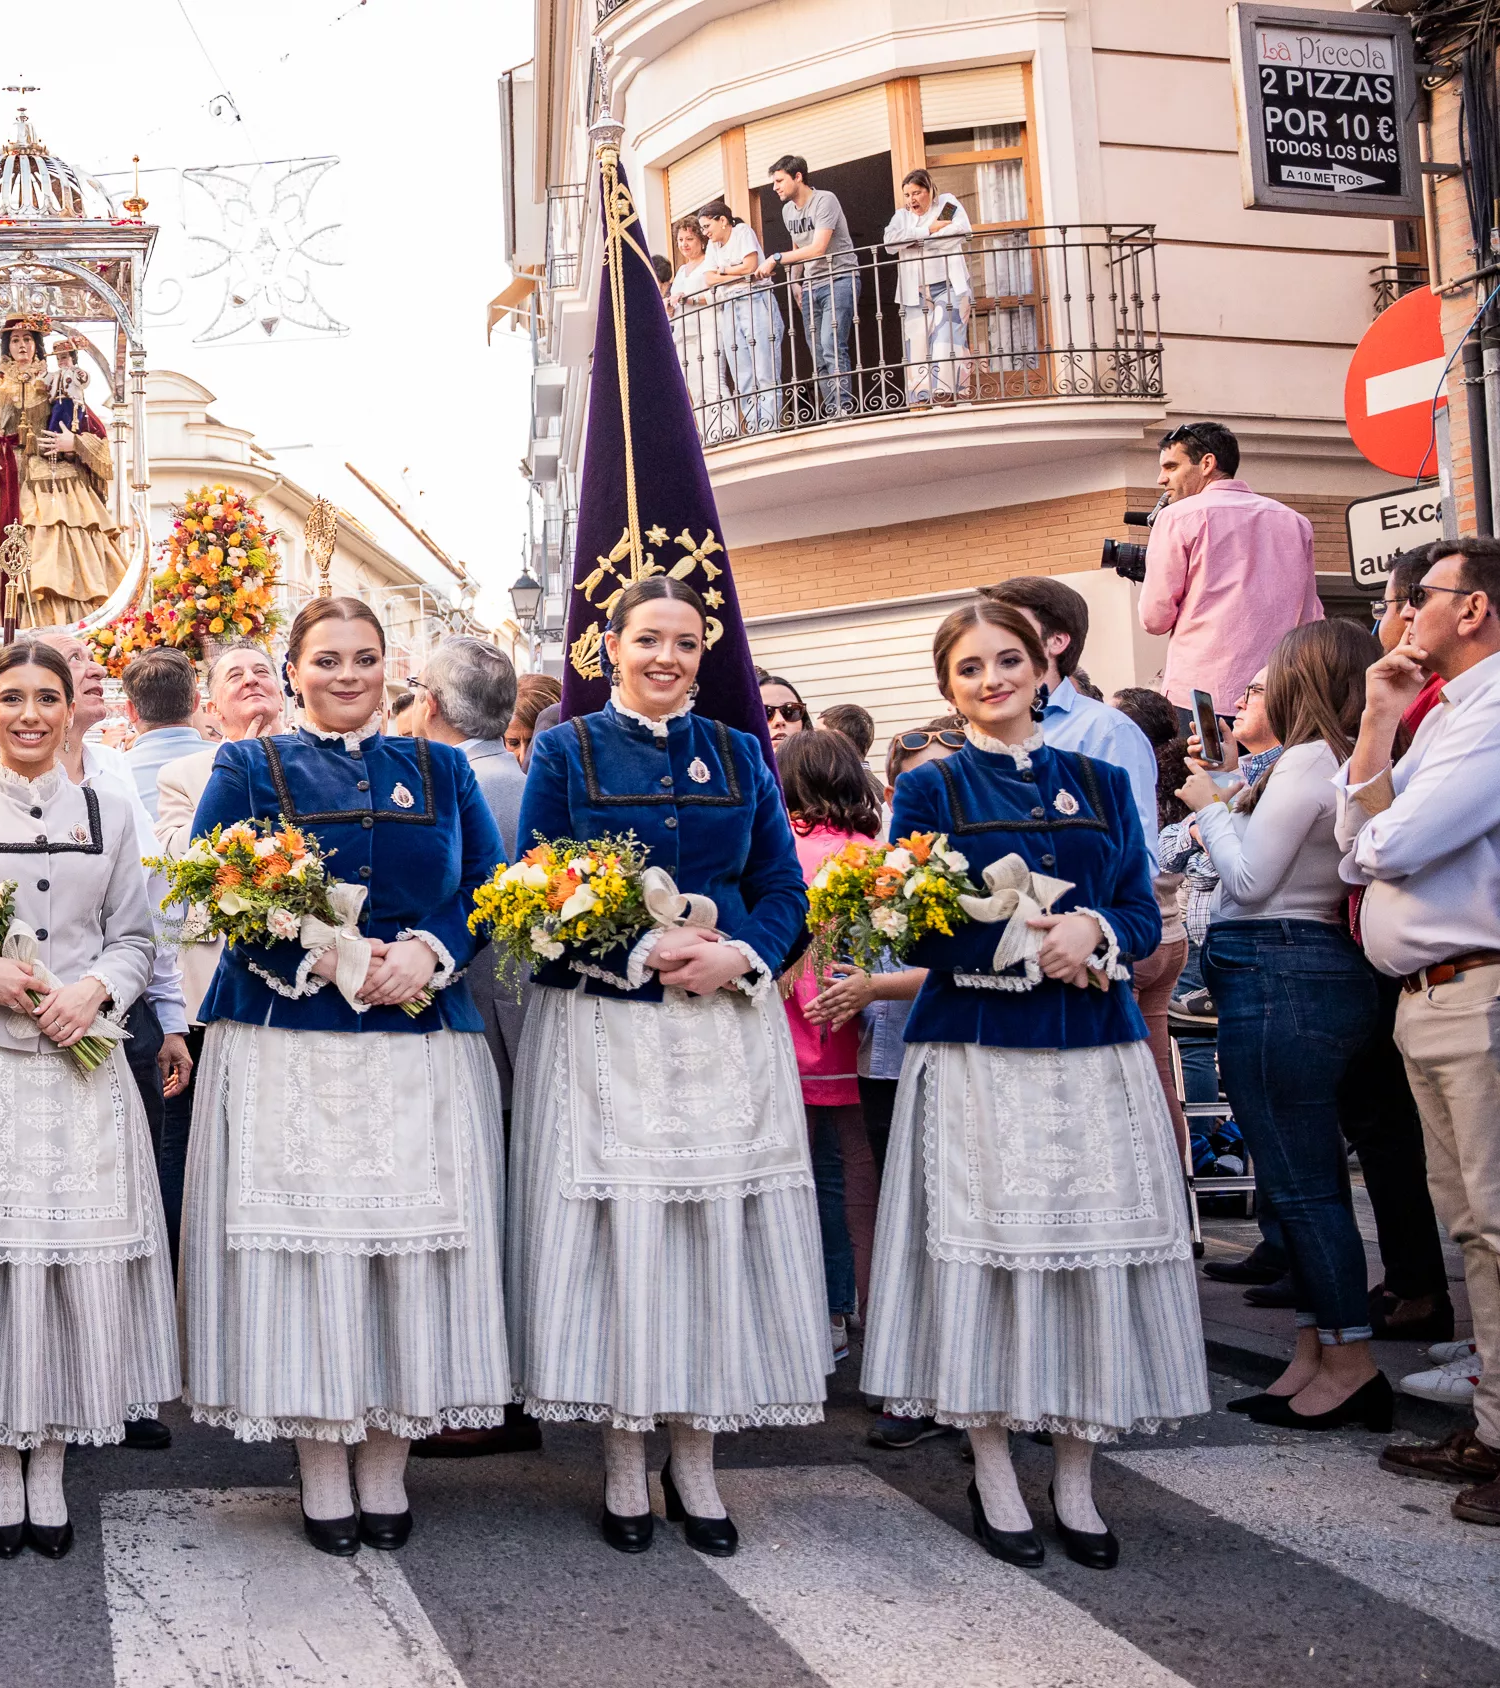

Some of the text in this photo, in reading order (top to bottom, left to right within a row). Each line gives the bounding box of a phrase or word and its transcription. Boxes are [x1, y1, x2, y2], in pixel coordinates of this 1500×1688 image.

[1262, 33, 1291, 62] La
[1261, 68, 1393, 104] 2 PIZZAS
[1265, 106, 1395, 143] POR 10 €
[1266, 138, 1397, 163] TODOS LOS DÍAS
[1286, 169, 1364, 186] A 10 METROS
